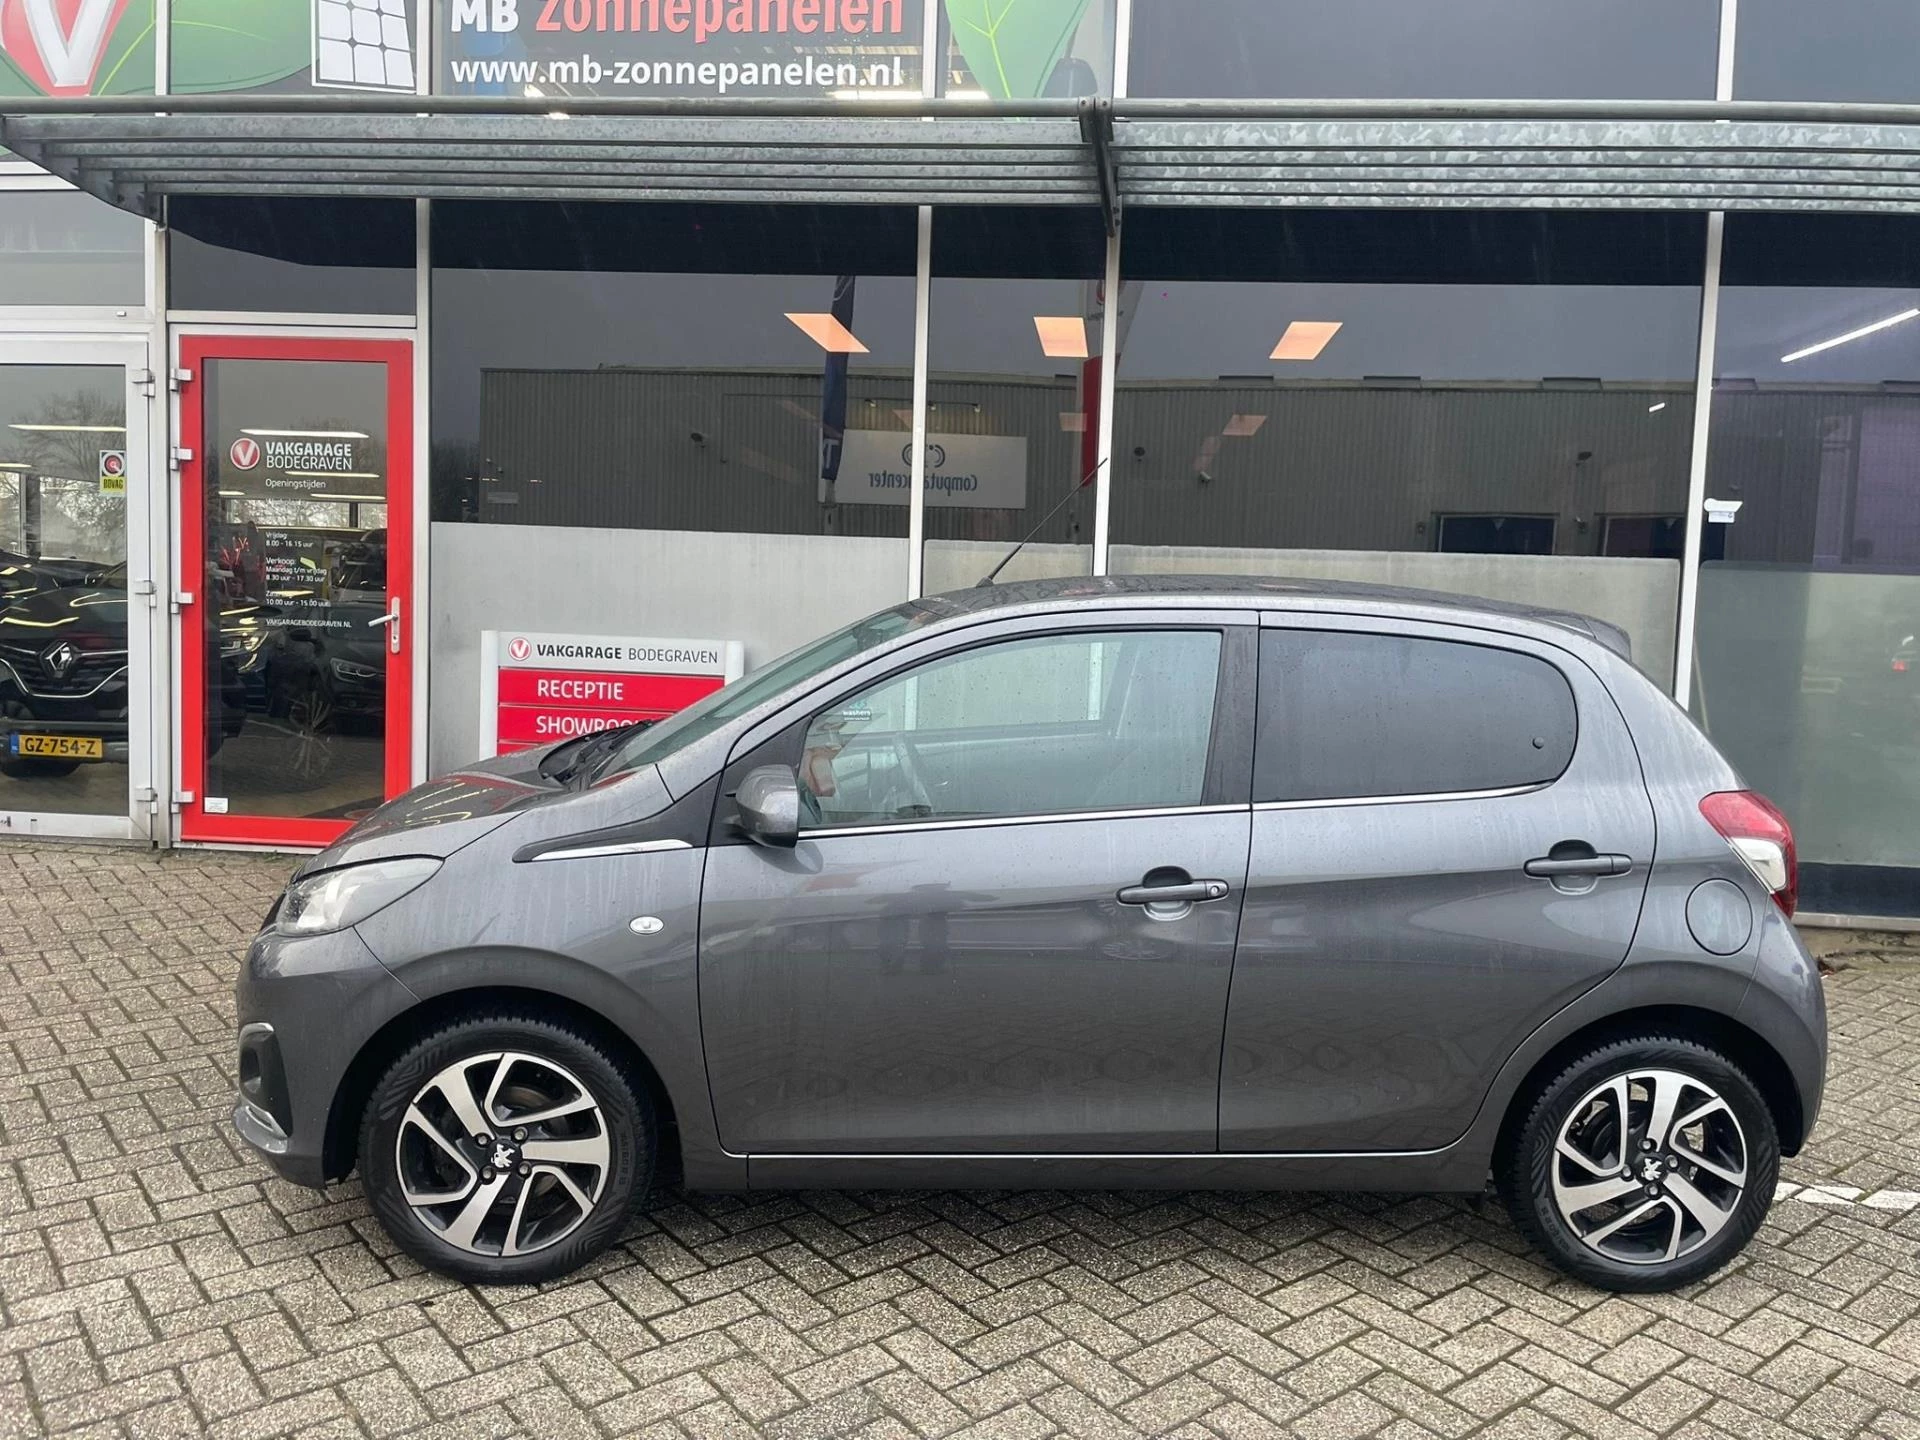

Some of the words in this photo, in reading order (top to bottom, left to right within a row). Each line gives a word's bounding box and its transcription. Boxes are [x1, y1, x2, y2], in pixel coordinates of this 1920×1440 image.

[450, 0, 520, 33] MB
[451, 55, 903, 94] www.mb-zonnepanelen.nl
[265, 441, 352, 457] VAKGARAGE
[266, 456, 353, 471] BODEGRAVEN
[265, 478, 327, 489] Openingstijden
[265, 566, 294, 575] Maandag
[294, 566, 306, 574] t/m
[537, 643, 622, 660] VAKGARAGE
[628, 647, 718, 664] BODEGRAVEN
[537, 679, 624, 701] RECEPTIE
[24, 737, 96, 755] GZ-754-Z
